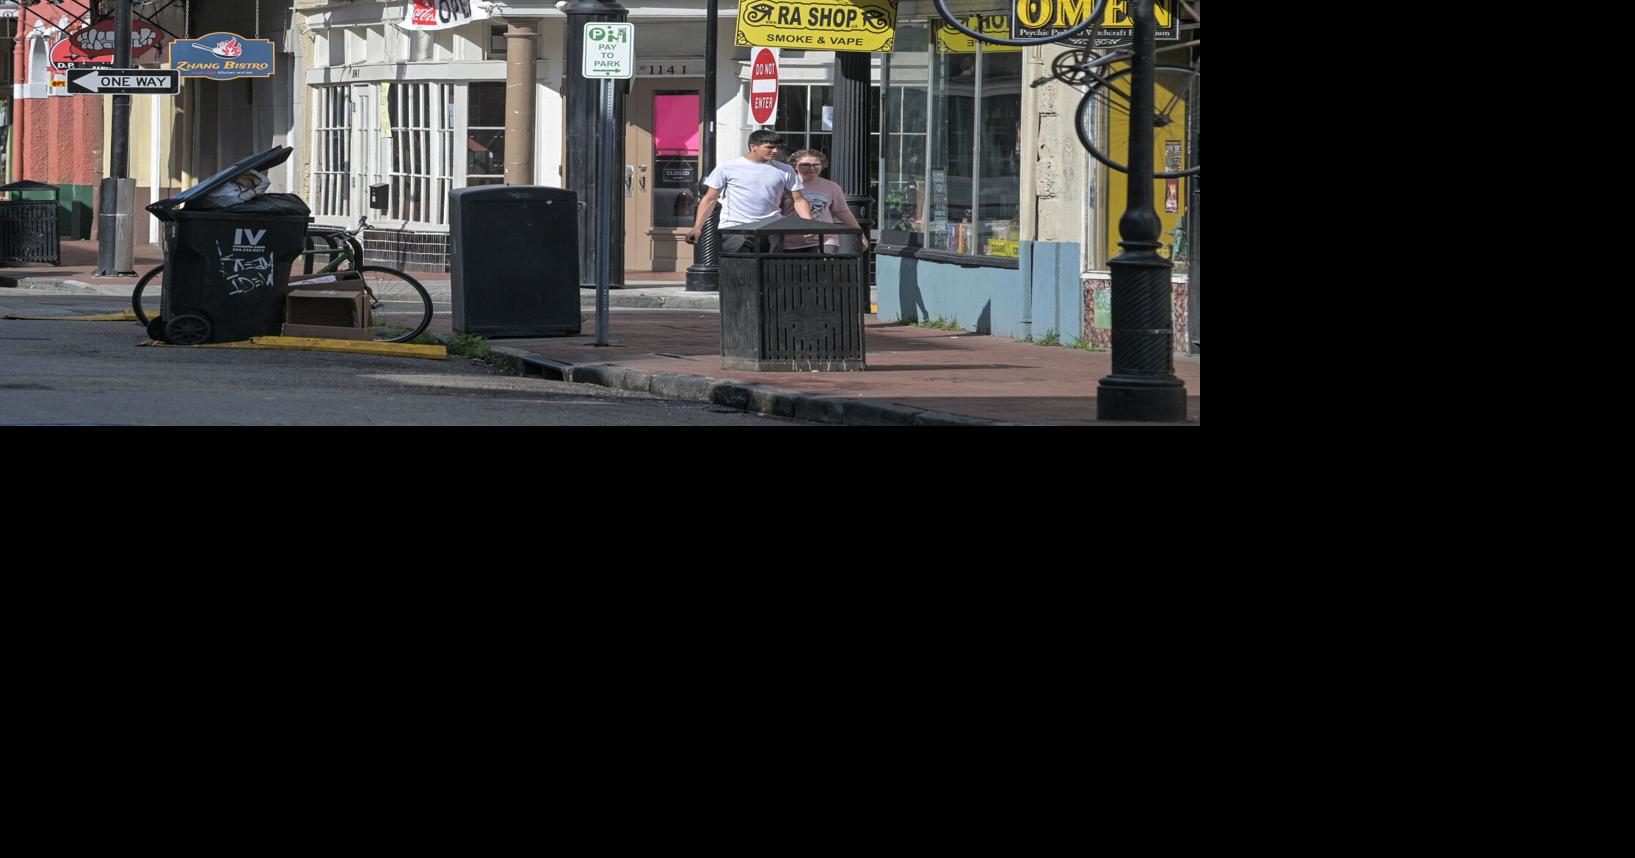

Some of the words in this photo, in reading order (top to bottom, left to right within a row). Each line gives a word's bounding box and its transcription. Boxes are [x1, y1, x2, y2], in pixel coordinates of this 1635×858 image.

[778, 6, 802, 25] RA
[808, 7, 859, 28] SHOP
[767, 33, 813, 44] SMOKE
[817, 36, 826, 44] &
[830, 37, 864, 46] VAPE
[1019, 29, 1049, 38] Psychic
[176, 61, 220, 71] ZHANG
[223, 61, 269, 71] BISTRO
[649, 65, 686, 75] 1141
[755, 64, 764, 75] DO
[765, 63, 775, 75] NOT
[101, 77, 131, 87] ONE
[136, 77, 167, 87] WAY
[755, 97, 773, 109] ENTER
[234, 228, 267, 246] IV
